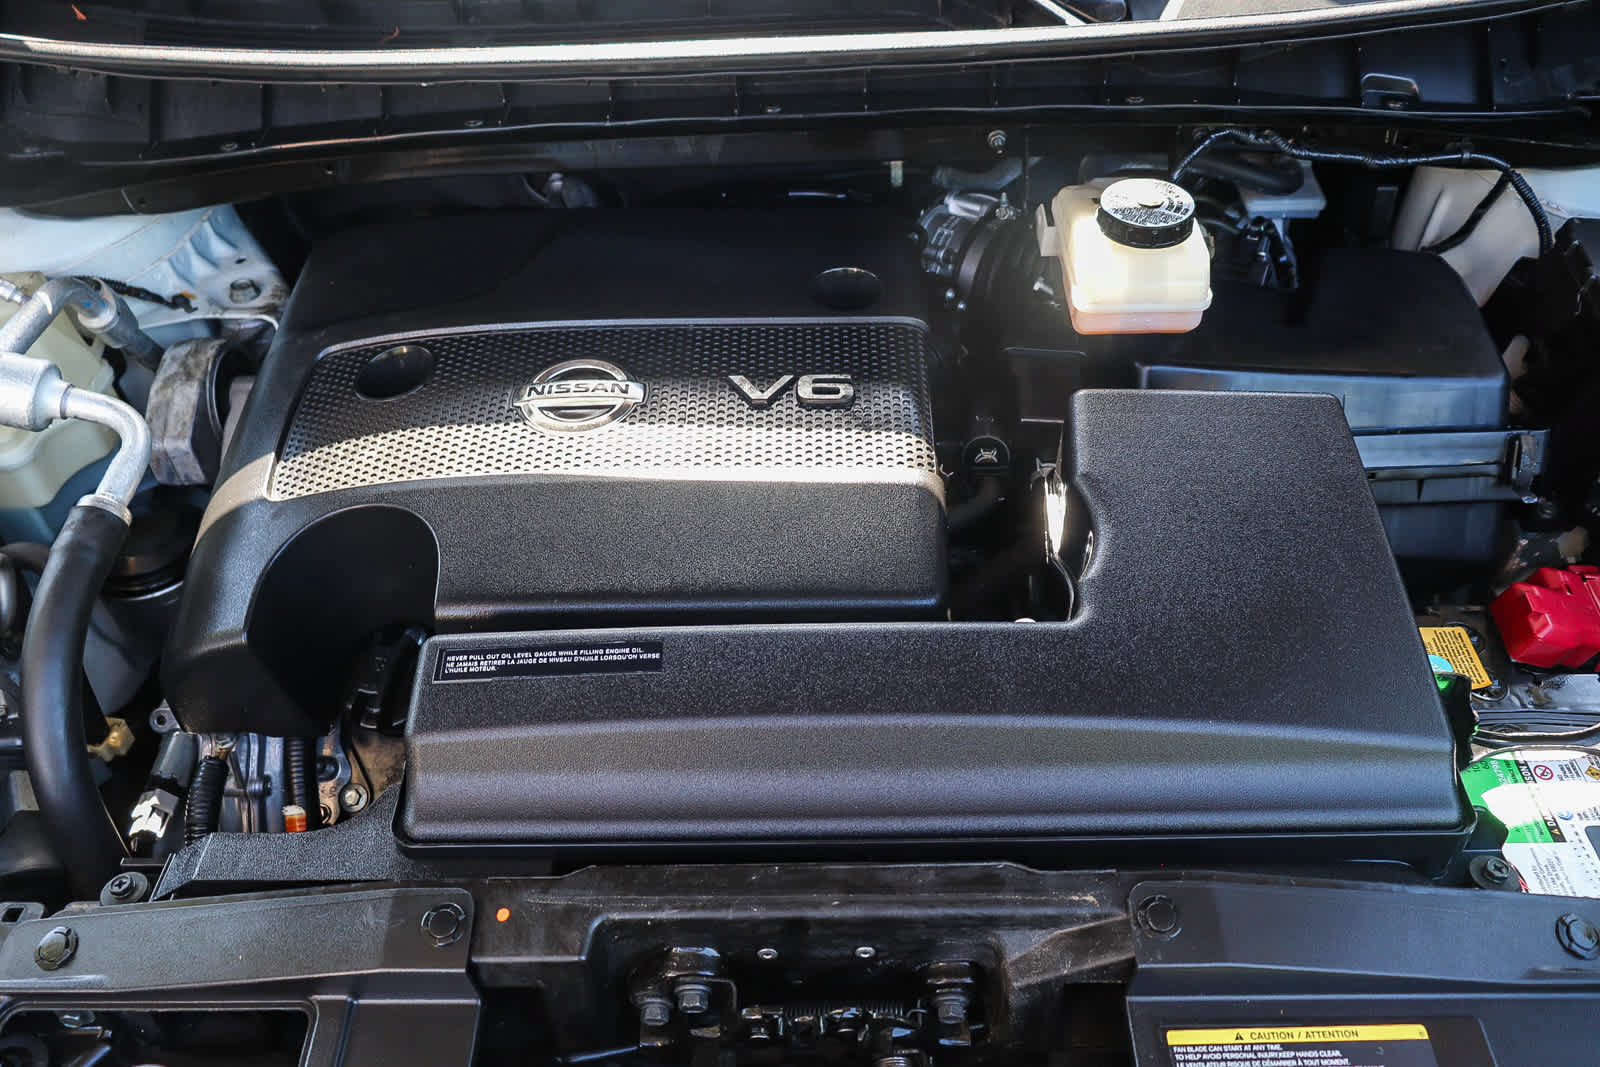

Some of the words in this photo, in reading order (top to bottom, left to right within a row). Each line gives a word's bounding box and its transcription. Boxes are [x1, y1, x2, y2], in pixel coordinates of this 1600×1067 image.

[526, 381, 630, 396] NISSAN
[728, 374, 855, 403] V6
[445, 666, 468, 674] L'HUILE
[1249, 1031, 1295, 1040] CAUTION
[1305, 1029, 1359, 1039] ATTENTION
